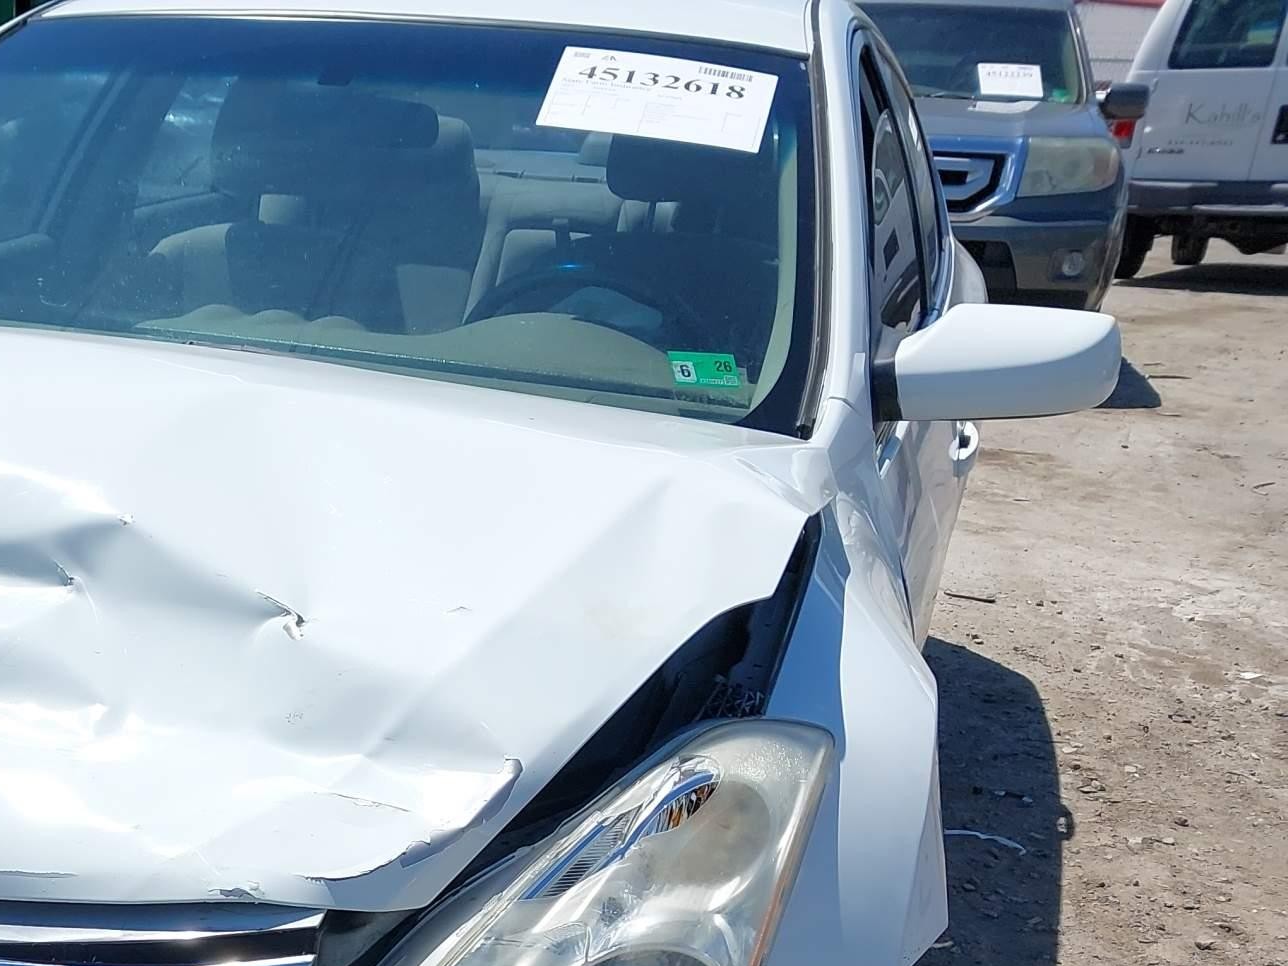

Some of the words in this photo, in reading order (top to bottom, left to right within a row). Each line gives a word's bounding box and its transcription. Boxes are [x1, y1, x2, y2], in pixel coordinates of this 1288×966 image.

[578, 64, 747, 100] 45132618
[680, 364, 691, 377] 6
[715, 360, 732, 372] 26
